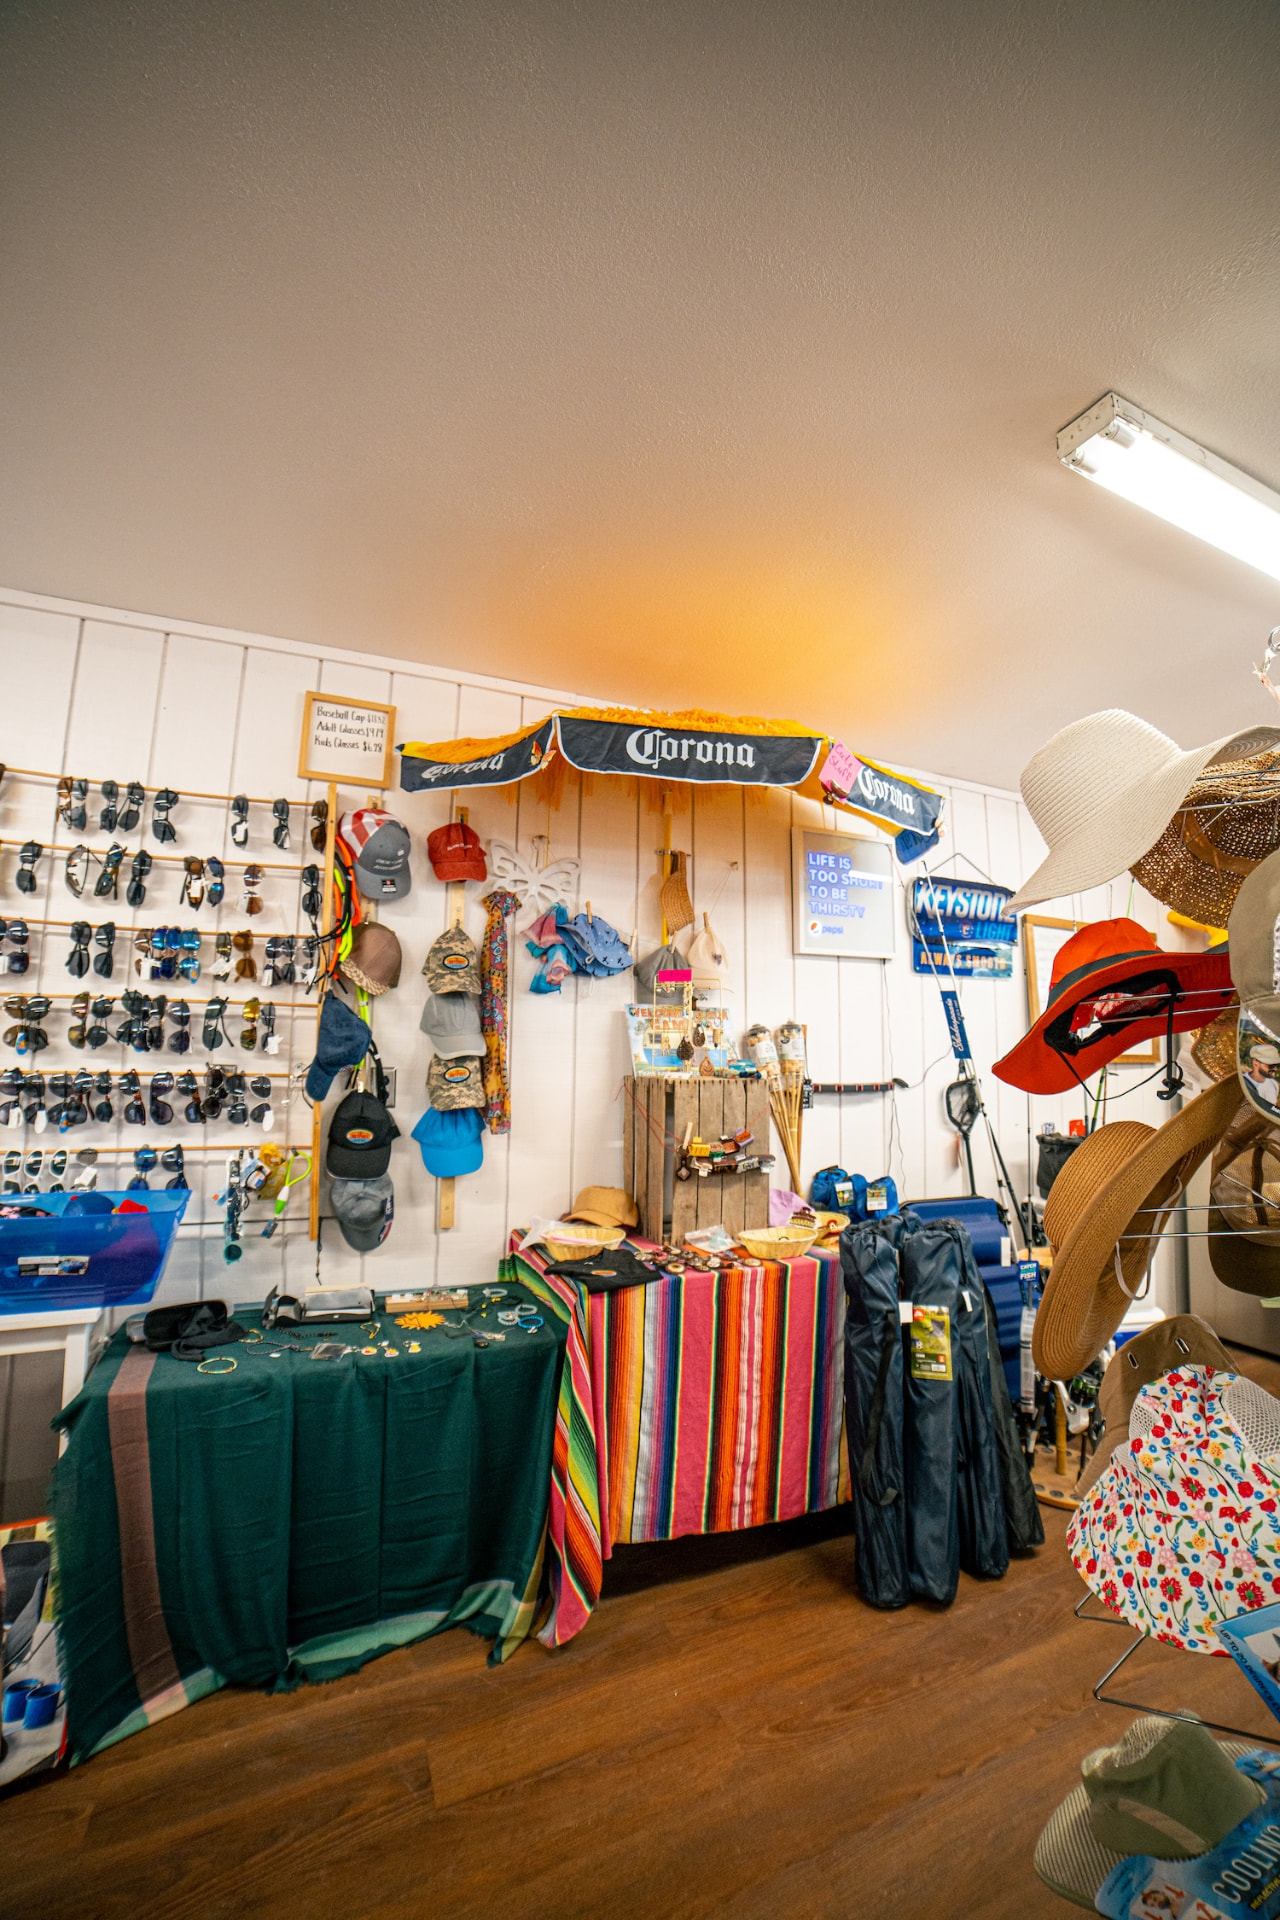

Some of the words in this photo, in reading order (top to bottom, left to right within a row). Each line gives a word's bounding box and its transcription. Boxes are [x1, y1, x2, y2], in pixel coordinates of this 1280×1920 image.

[317, 706, 349, 720] Baseball
[352, 711, 365, 723] Cap
[340, 723, 365, 736] Glasses
[314, 734, 332, 748] Kids
[334, 737, 359, 750] Glasses
[626, 728, 755, 769] Corona
[835, 744, 853, 769] Cute
[857, 766, 915, 815] Corona
[808, 852, 836, 868] LIFE
[839, 857, 851, 870] IS
[809, 869, 838, 884] TOO
[809, 885, 828, 899] TO
[831, 887, 848, 900] BE
[809, 901, 866, 918] THIRSTY
[975, 922, 1013, 941] LIGHT
[920, 951, 963, 967] ALWAYS
[965, 954, 1006, 970] SMOOTH
[631, 1006, 684, 1019] WELCOM
[1220, 1628, 1231, 1640] UP
[1229, 1640, 1240, 1652] TO
